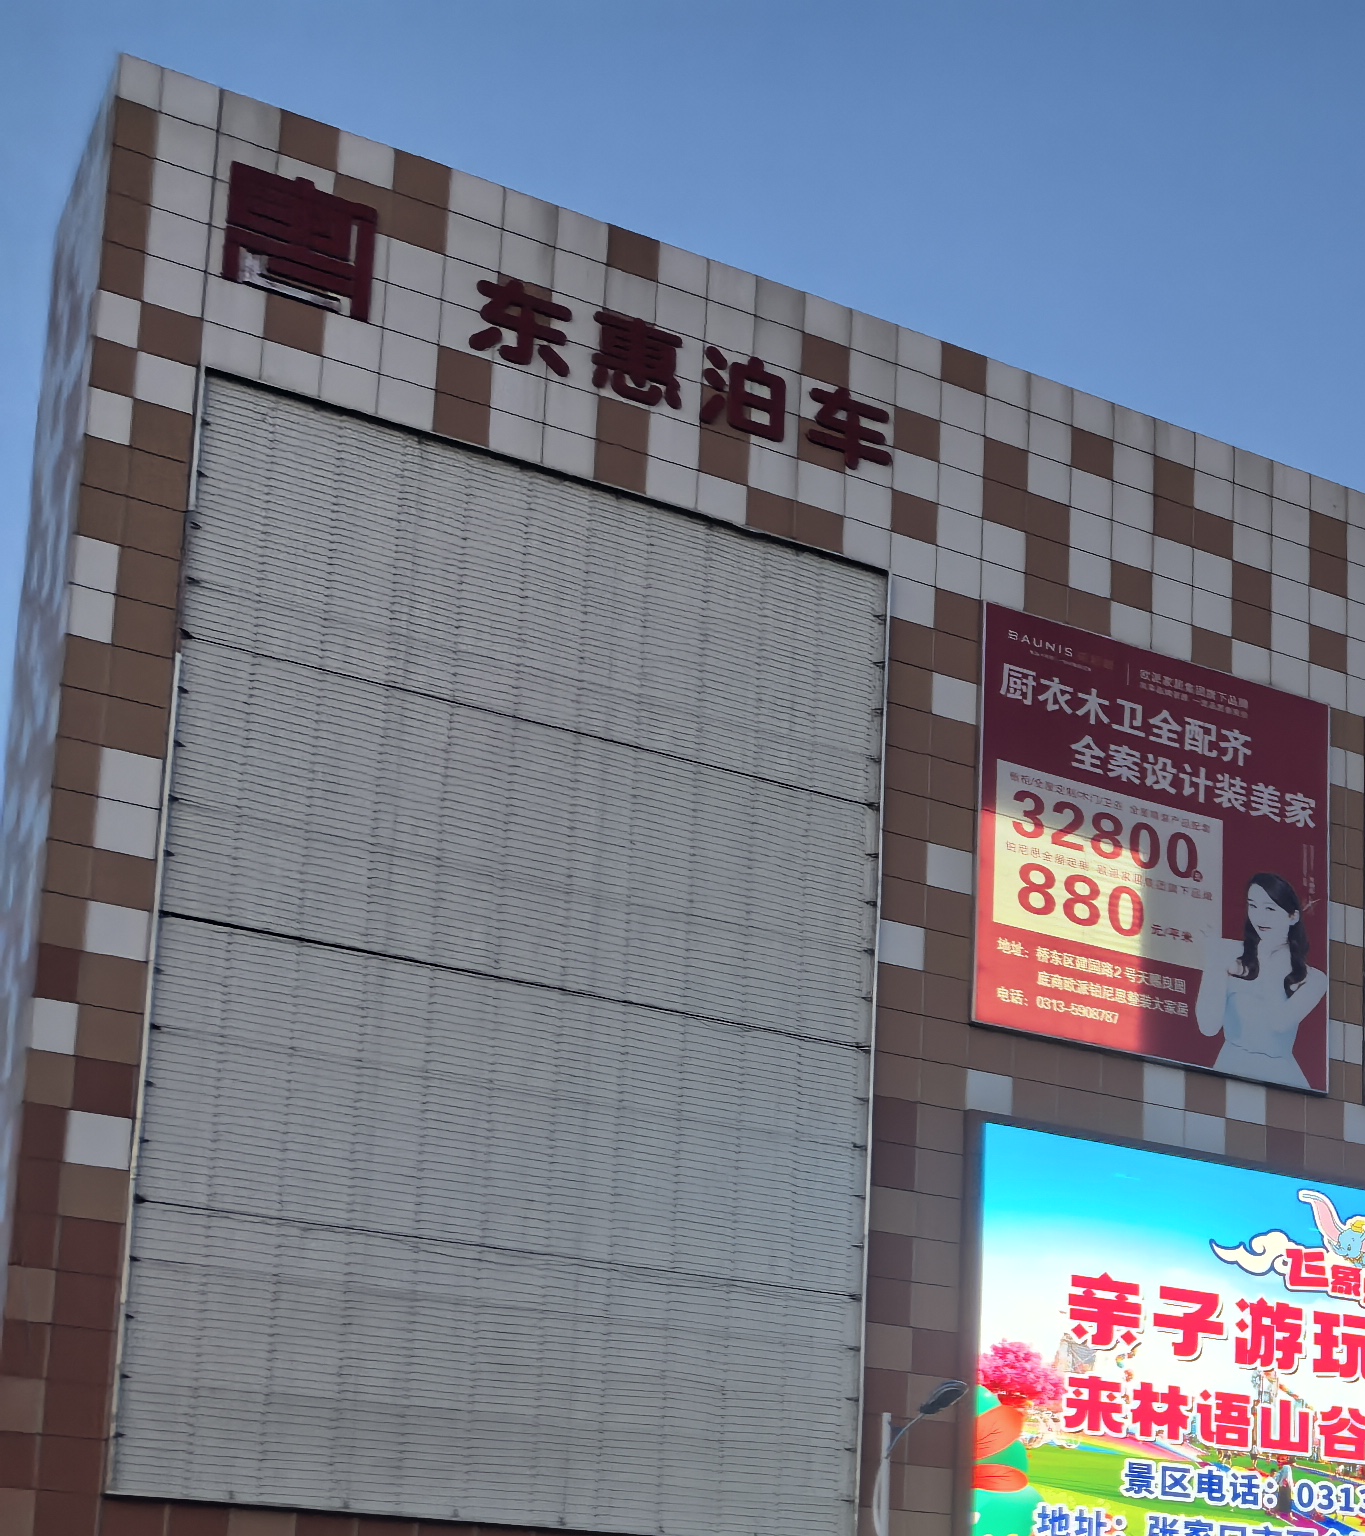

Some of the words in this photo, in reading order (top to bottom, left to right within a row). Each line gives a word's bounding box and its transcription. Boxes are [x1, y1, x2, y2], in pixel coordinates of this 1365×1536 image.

[469, 277, 892, 470] 东惠泊车
[1008, 629, 1074, 657] BAUNIS
[1000, 662, 1252, 767] 厨衣木卫全配齐
[1069, 734, 1317, 831] 全案设计装美家
[1012, 789, 1199, 879] 32800
[1018, 862, 1145, 937] 880
